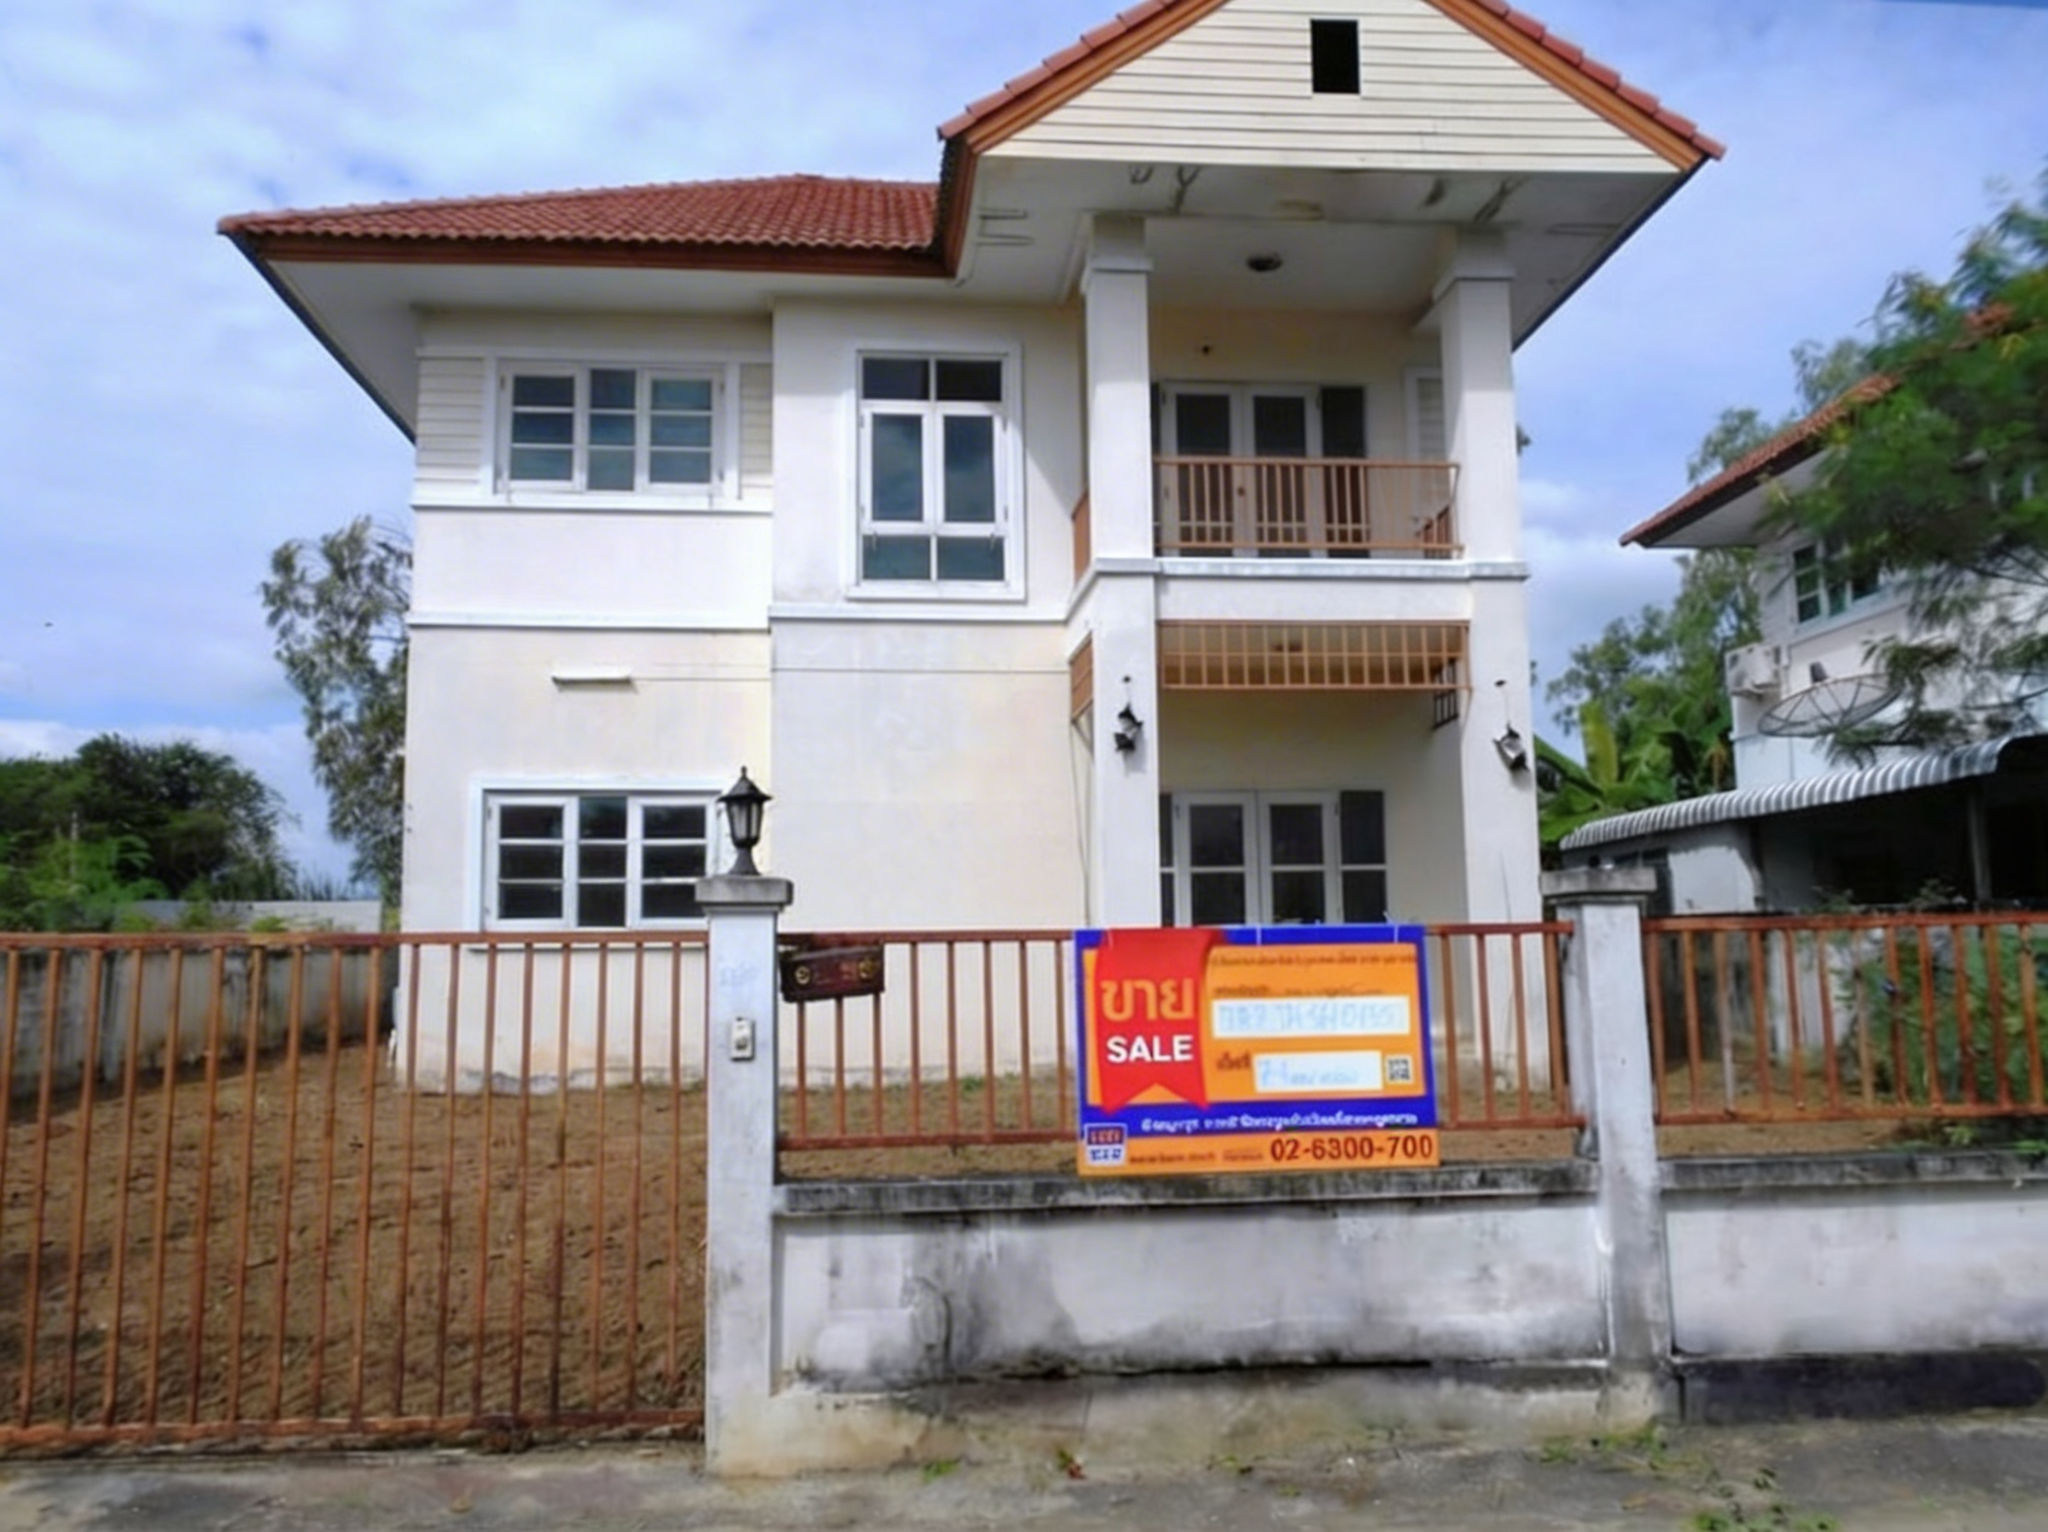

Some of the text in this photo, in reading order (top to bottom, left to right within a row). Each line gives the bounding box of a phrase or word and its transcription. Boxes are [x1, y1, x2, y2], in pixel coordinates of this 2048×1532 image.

[1100, 978, 1194, 1021] ขาย
[1106, 1034, 1194, 1062] SALE
[1270, 1134, 1433, 1163] 02-6300-700
